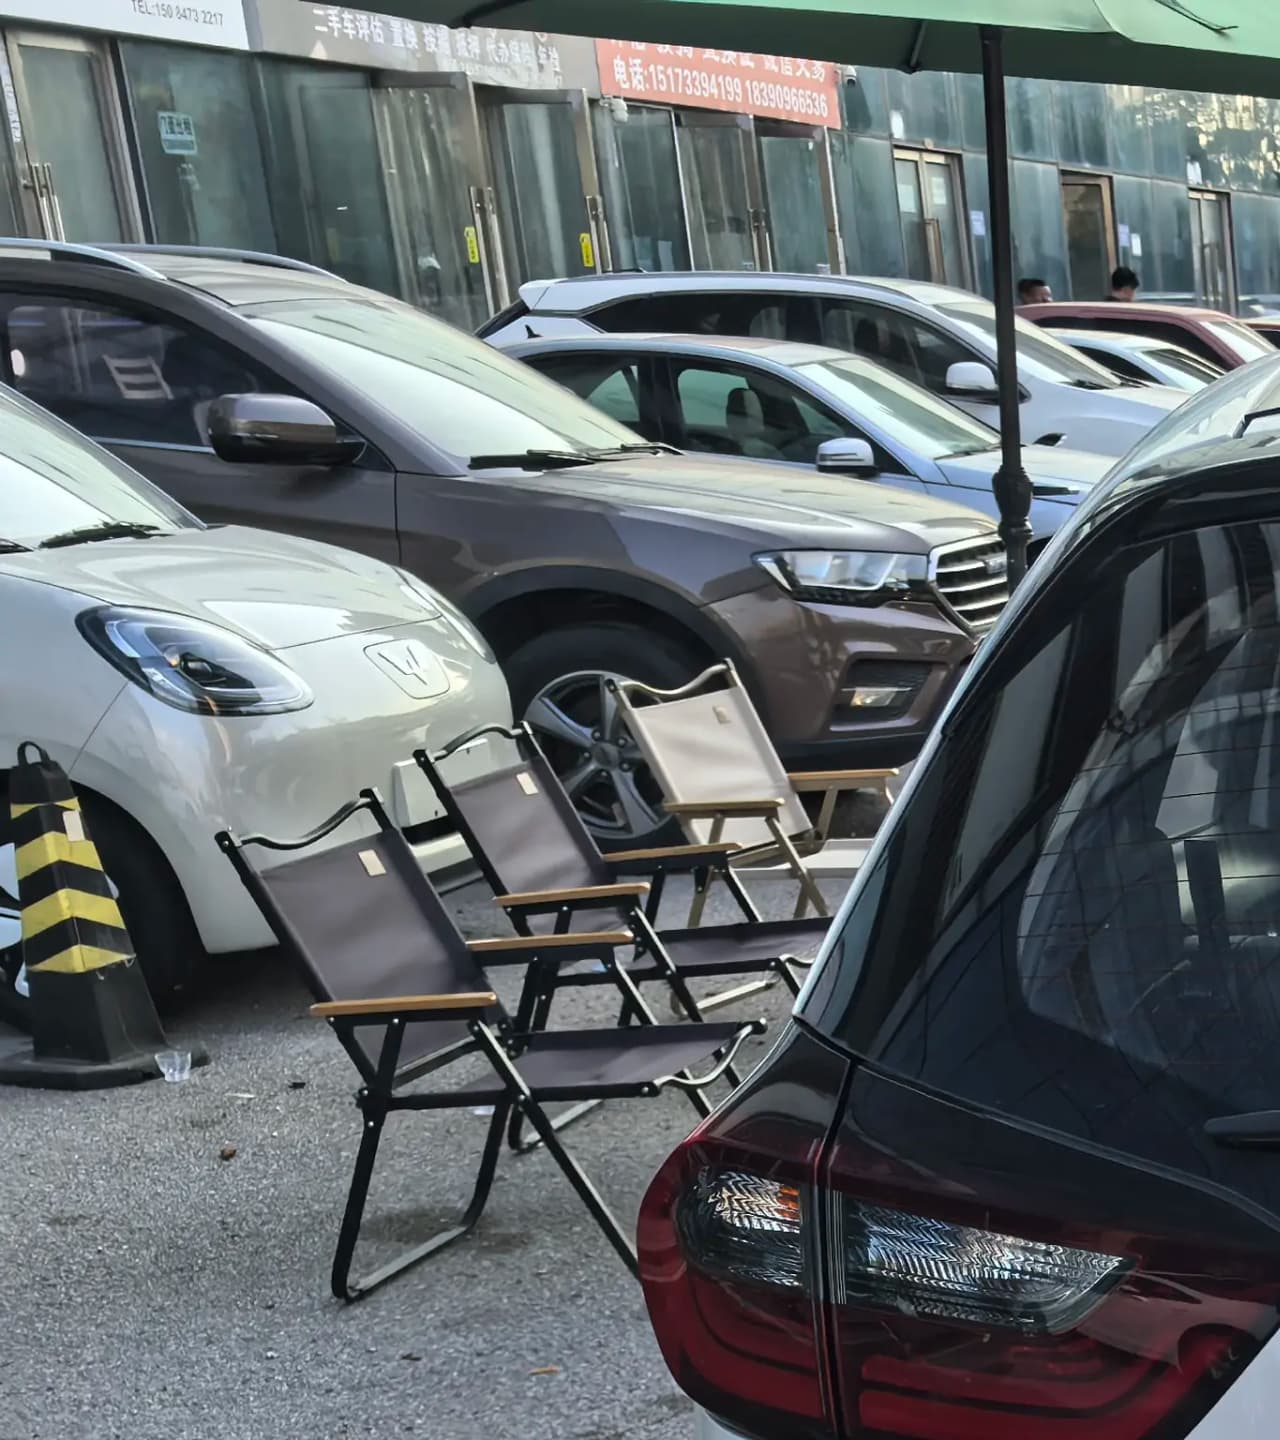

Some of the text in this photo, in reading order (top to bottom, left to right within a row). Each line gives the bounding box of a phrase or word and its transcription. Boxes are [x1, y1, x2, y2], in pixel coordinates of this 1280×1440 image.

[201, 10, 224, 25] 2217
[312, 5, 385, 44] 二手车评估
[612, 55, 743, 104] 电话:15173394199
[745, 79, 829, 118] 18390966536
